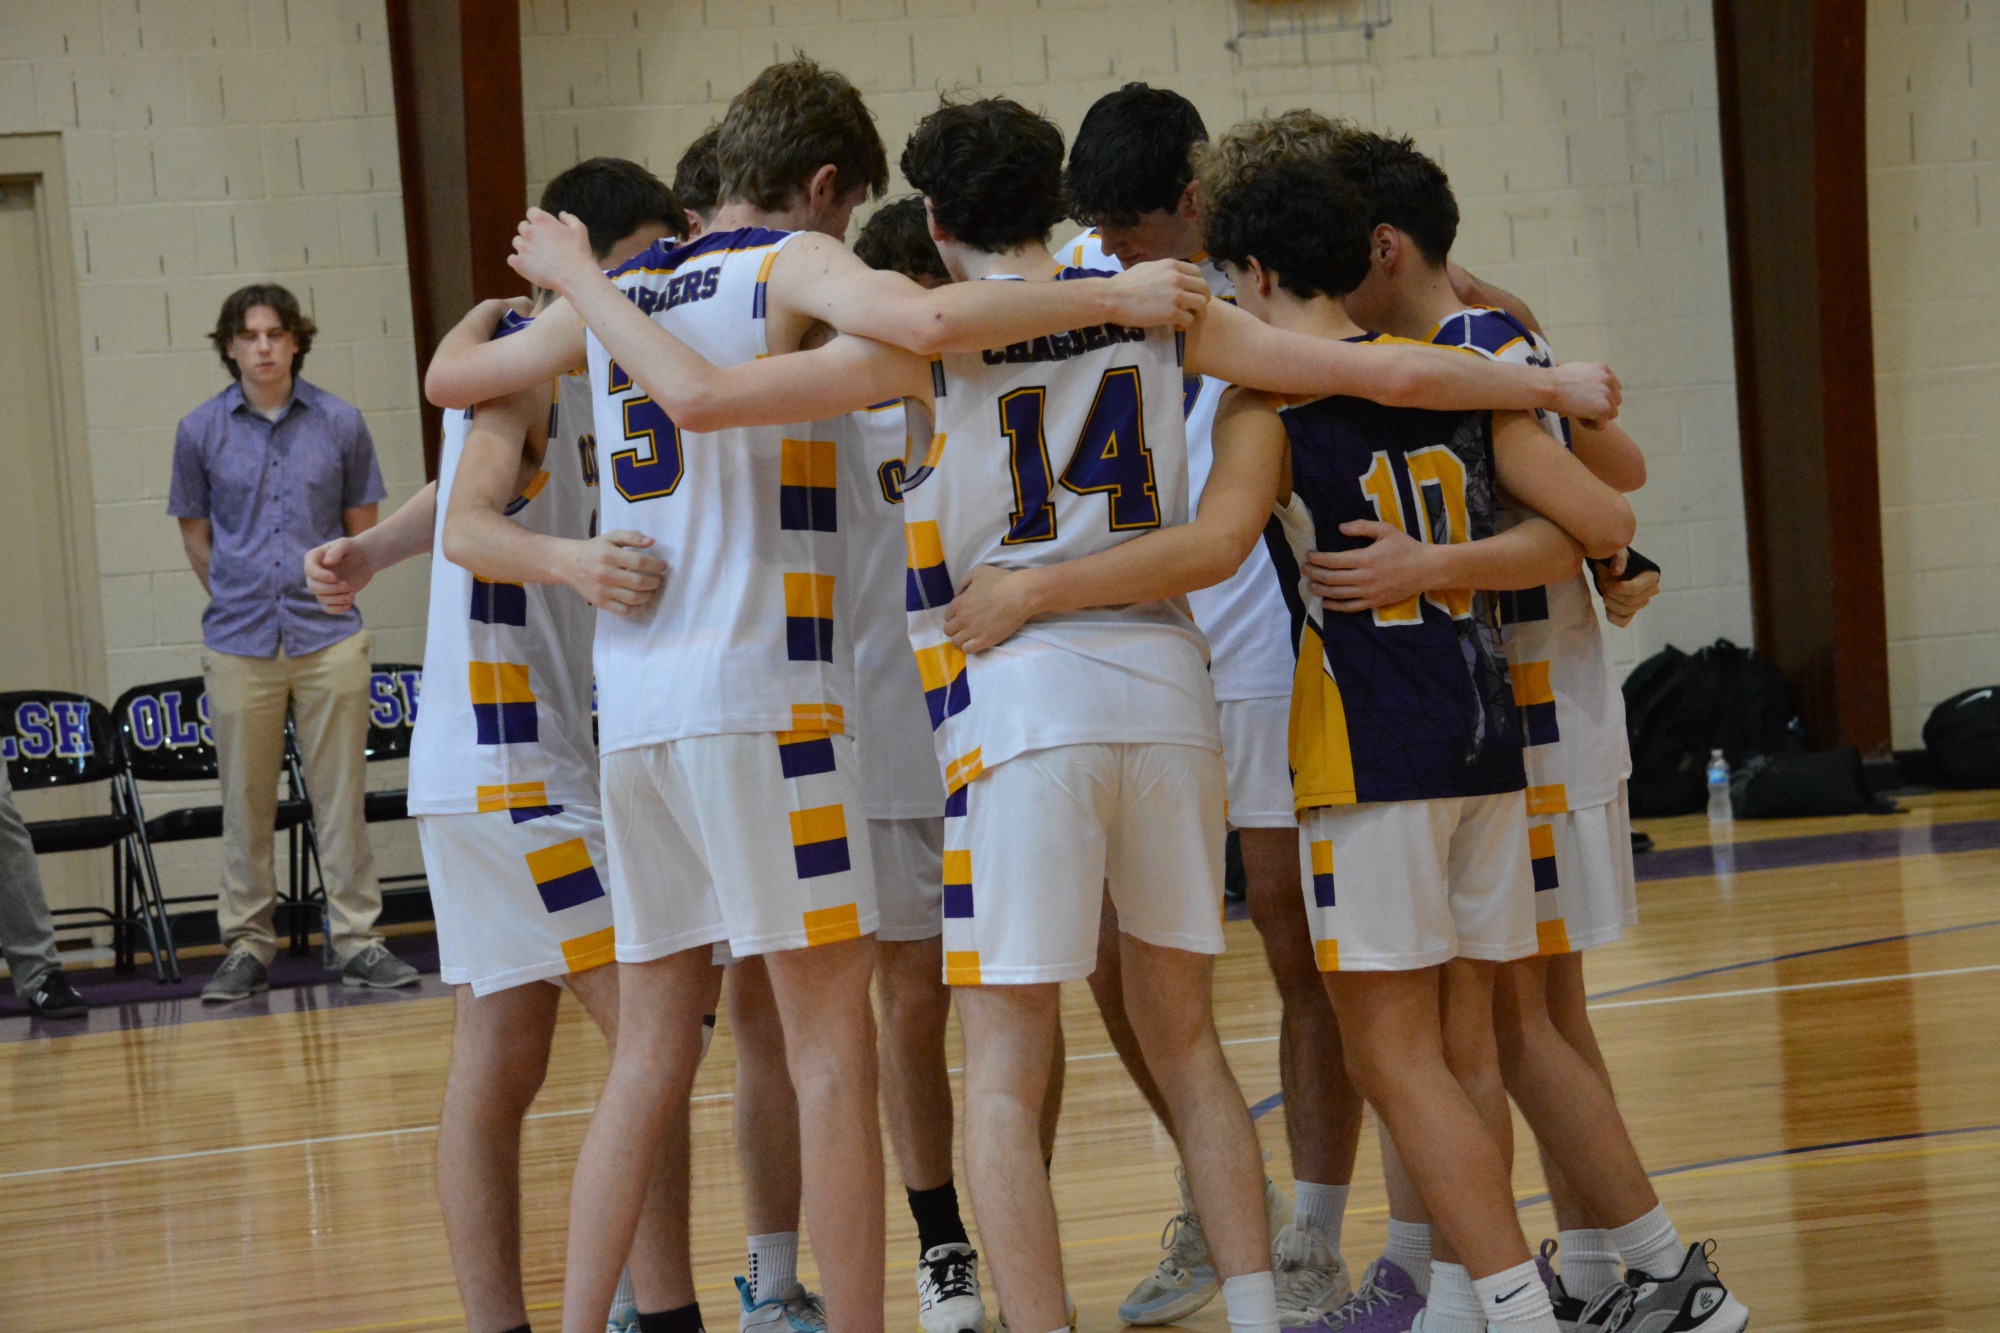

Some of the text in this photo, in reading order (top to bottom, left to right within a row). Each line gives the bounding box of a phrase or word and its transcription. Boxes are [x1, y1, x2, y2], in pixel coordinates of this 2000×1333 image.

[609, 358, 685, 503] 3
[998, 365, 1161, 546] 14
[127, 691, 216, 751] OL
